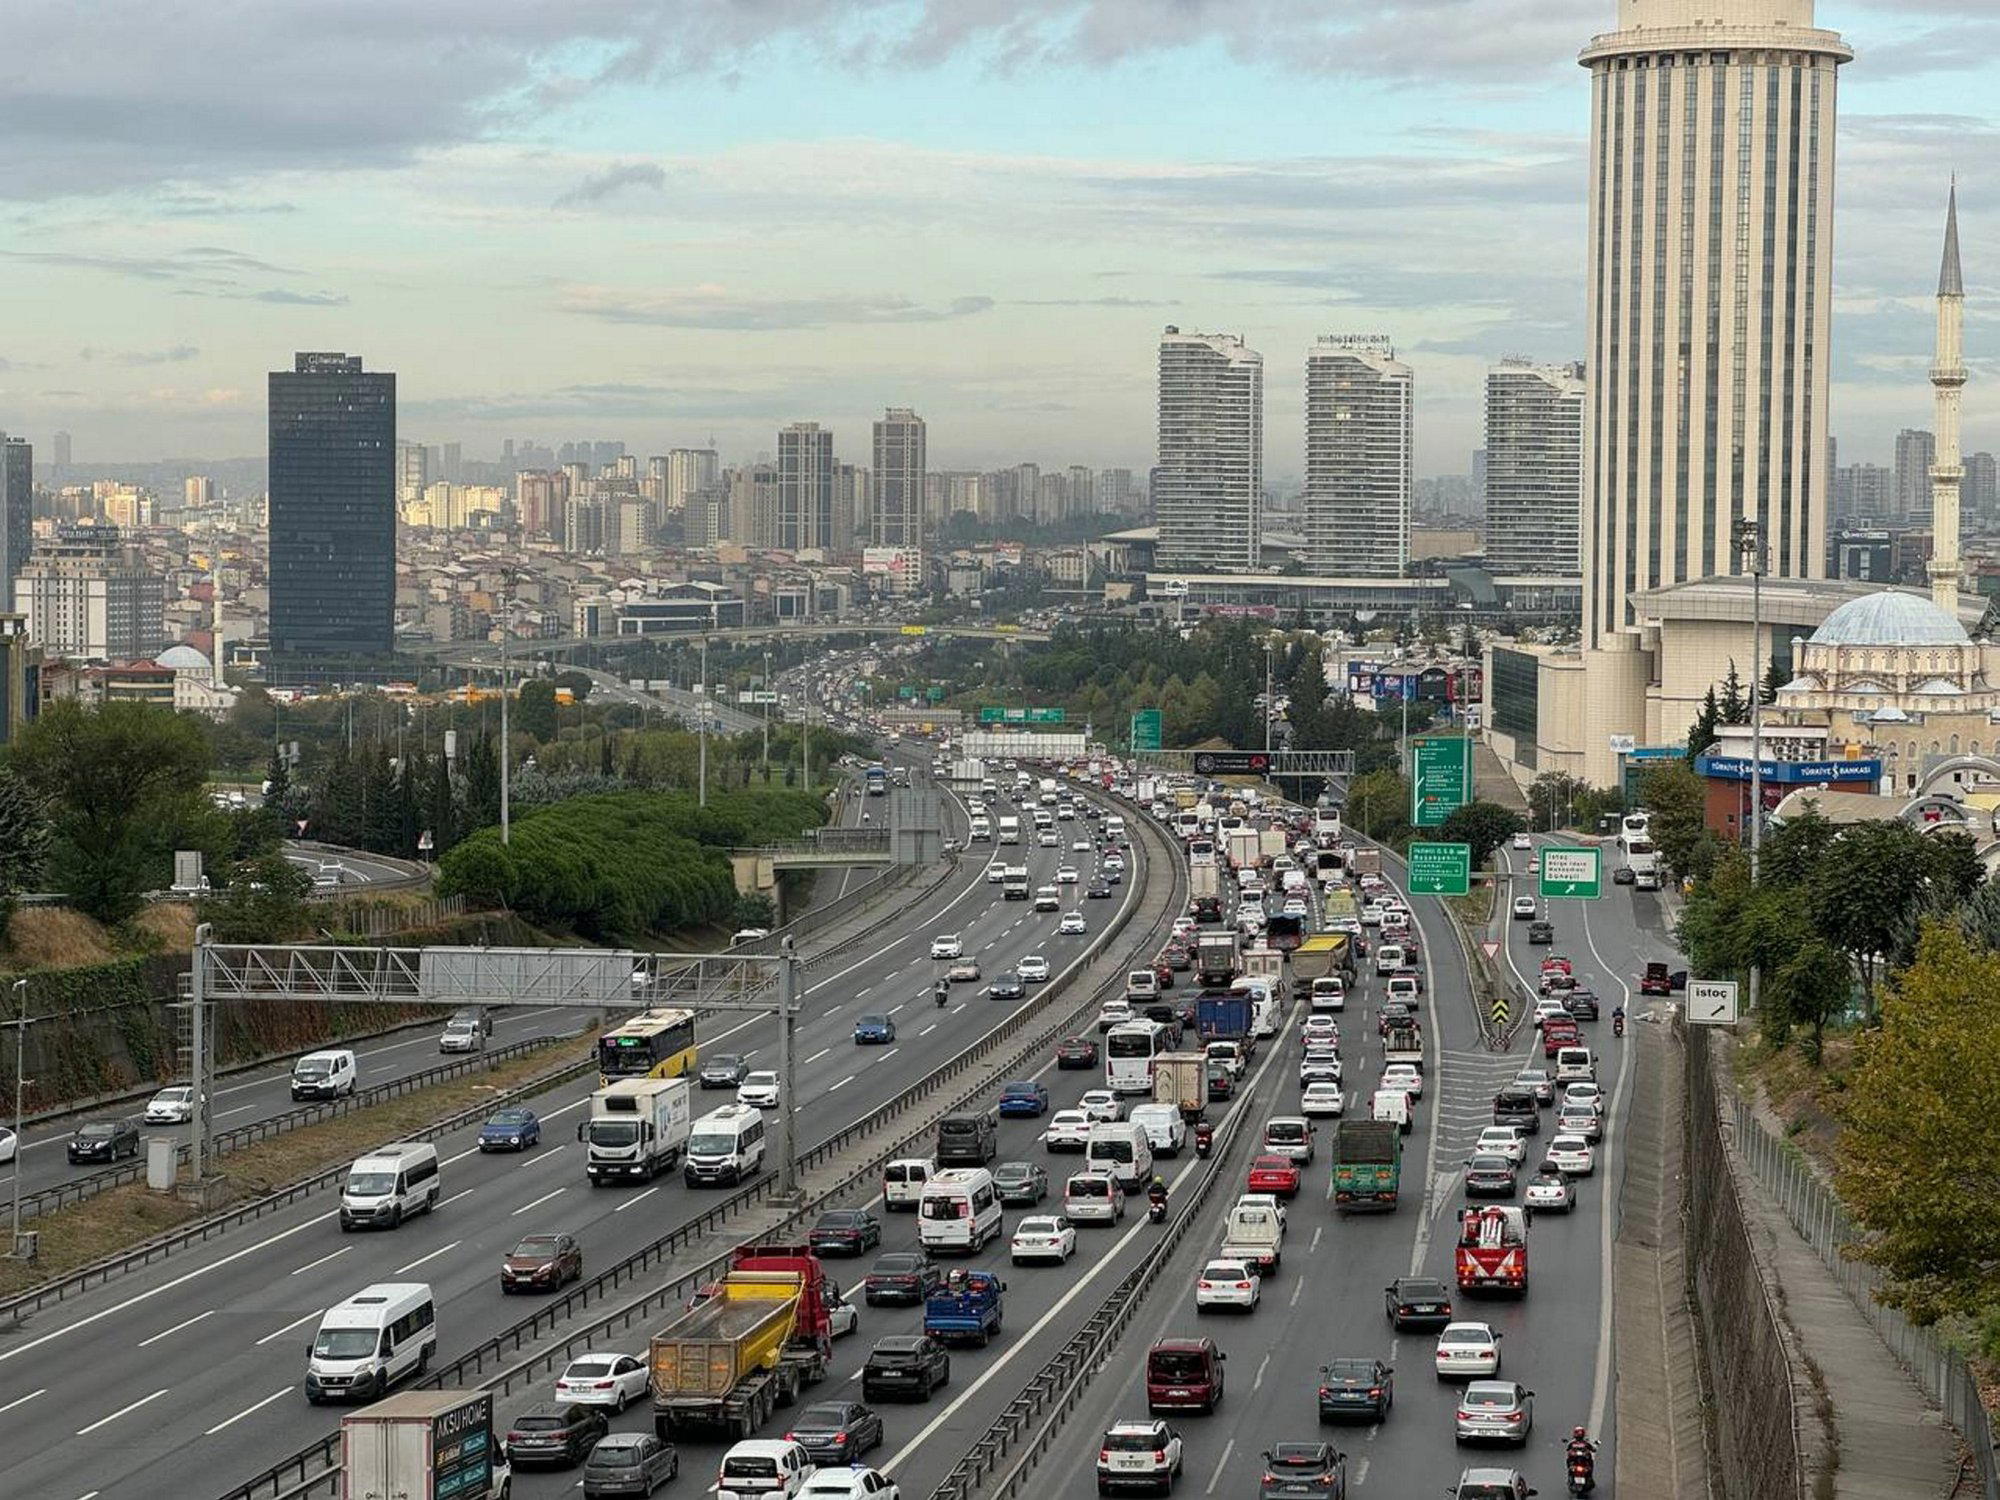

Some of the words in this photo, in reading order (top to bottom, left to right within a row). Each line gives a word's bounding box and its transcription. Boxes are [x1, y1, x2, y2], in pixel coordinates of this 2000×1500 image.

[1711, 763, 1739, 773] TÜRKİYE
[1745, 766, 1774, 775] BAKASI
[1800, 766, 1832, 777] TÜRKİYE
[1839, 767, 1871, 776] BANKASI
[437, 1410, 461, 1439] AKSU
[462, 1400, 487, 1428] HOME
